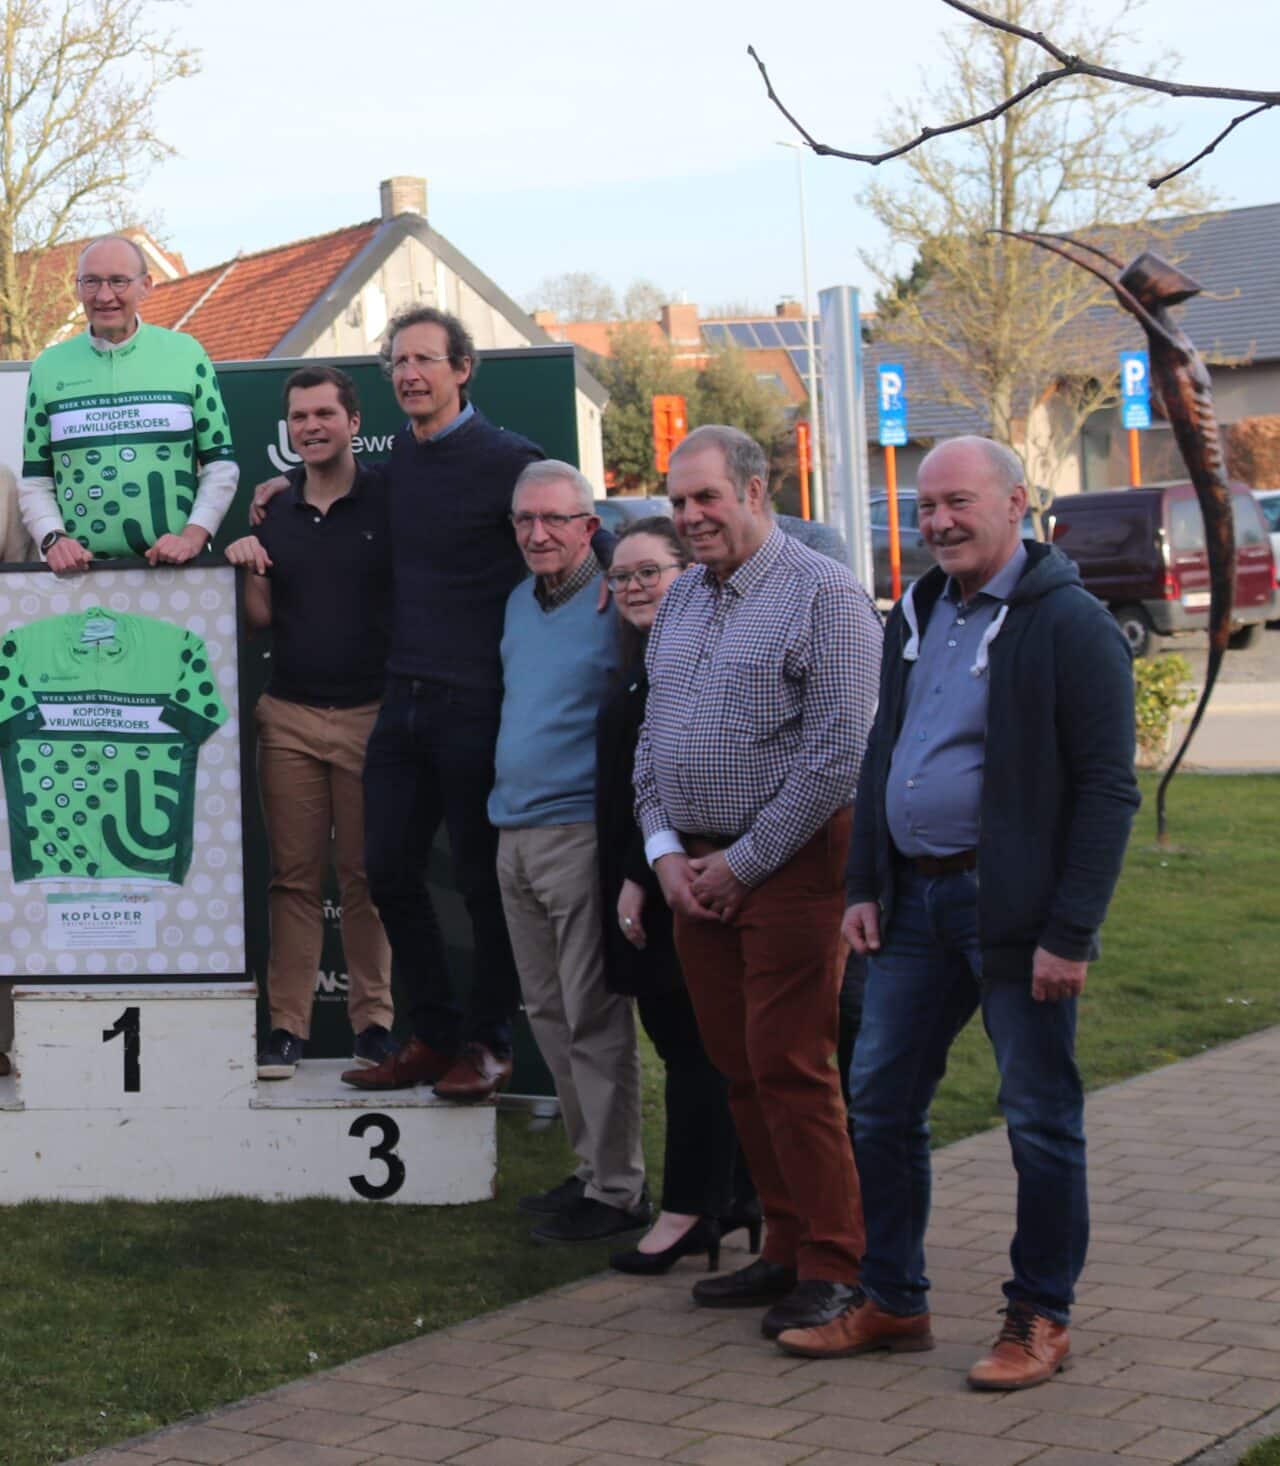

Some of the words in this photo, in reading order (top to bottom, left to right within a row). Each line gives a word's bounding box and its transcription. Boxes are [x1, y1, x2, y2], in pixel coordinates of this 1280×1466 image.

[1125, 359, 1145, 396] P
[881, 372, 902, 411] P
[81, 398, 97, 407] VAN
[100, 397, 111, 405] DE
[113, 394, 173, 404] VRIJWILLIGER
[86, 408, 140, 422] KOPLOPER
[63, 418, 171, 435] VRIJWILLIGERSKOERS
[67, 694, 82, 702] VAN
[86, 693, 97, 701] DE
[98, 694, 157, 704] VRIJWILLIGER
[72, 707, 123, 717] KOPLOPER
[48, 718, 150, 729] VRIJWILLIGERSKOERS
[61, 911, 142, 921] KOPLOPER
[103, 1007, 141, 1092] 1
[348, 1112, 406, 1200] 3
